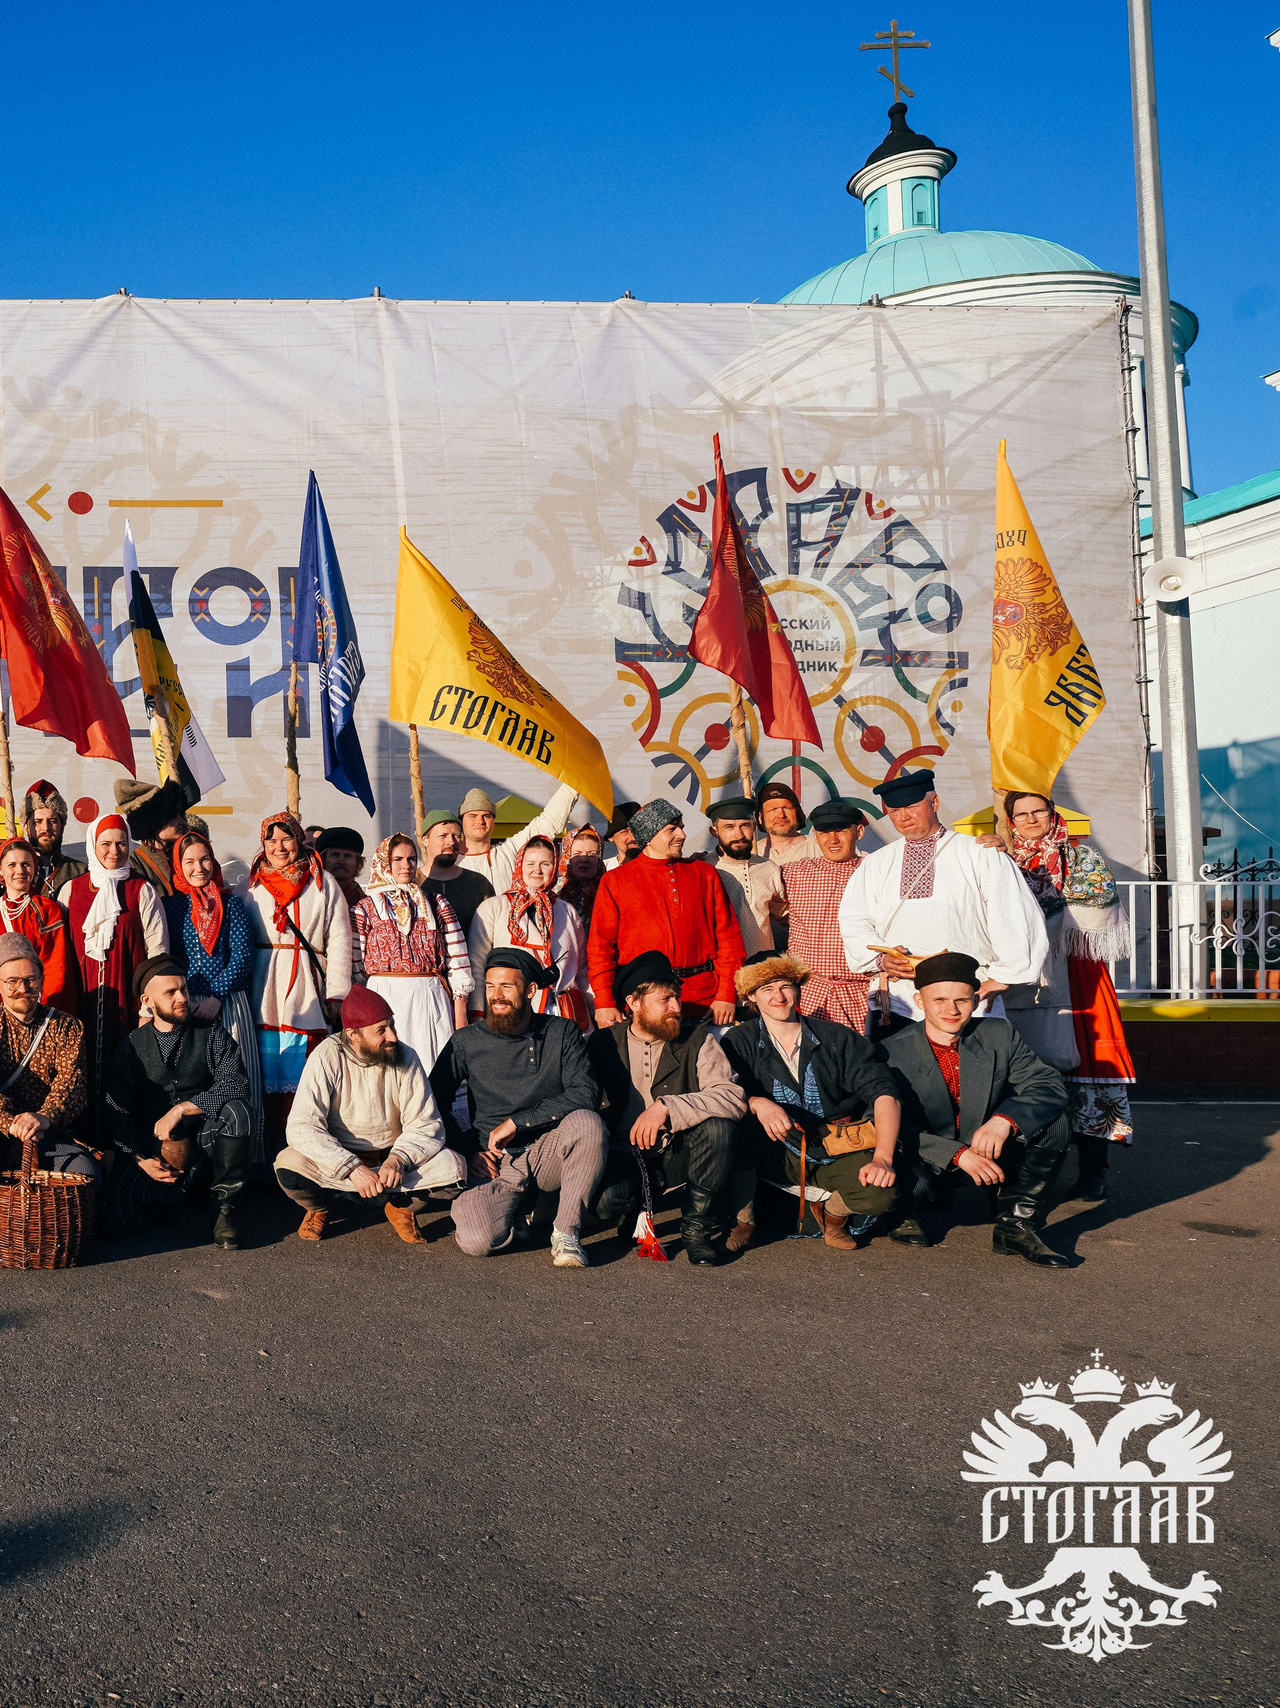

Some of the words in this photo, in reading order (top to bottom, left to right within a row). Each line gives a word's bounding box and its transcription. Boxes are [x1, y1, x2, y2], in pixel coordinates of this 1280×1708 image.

[780, 616, 832, 631] ССКИЙ
[796, 660, 839, 674] ДНИК
[428, 684, 556, 766] СТОГЛАВ
